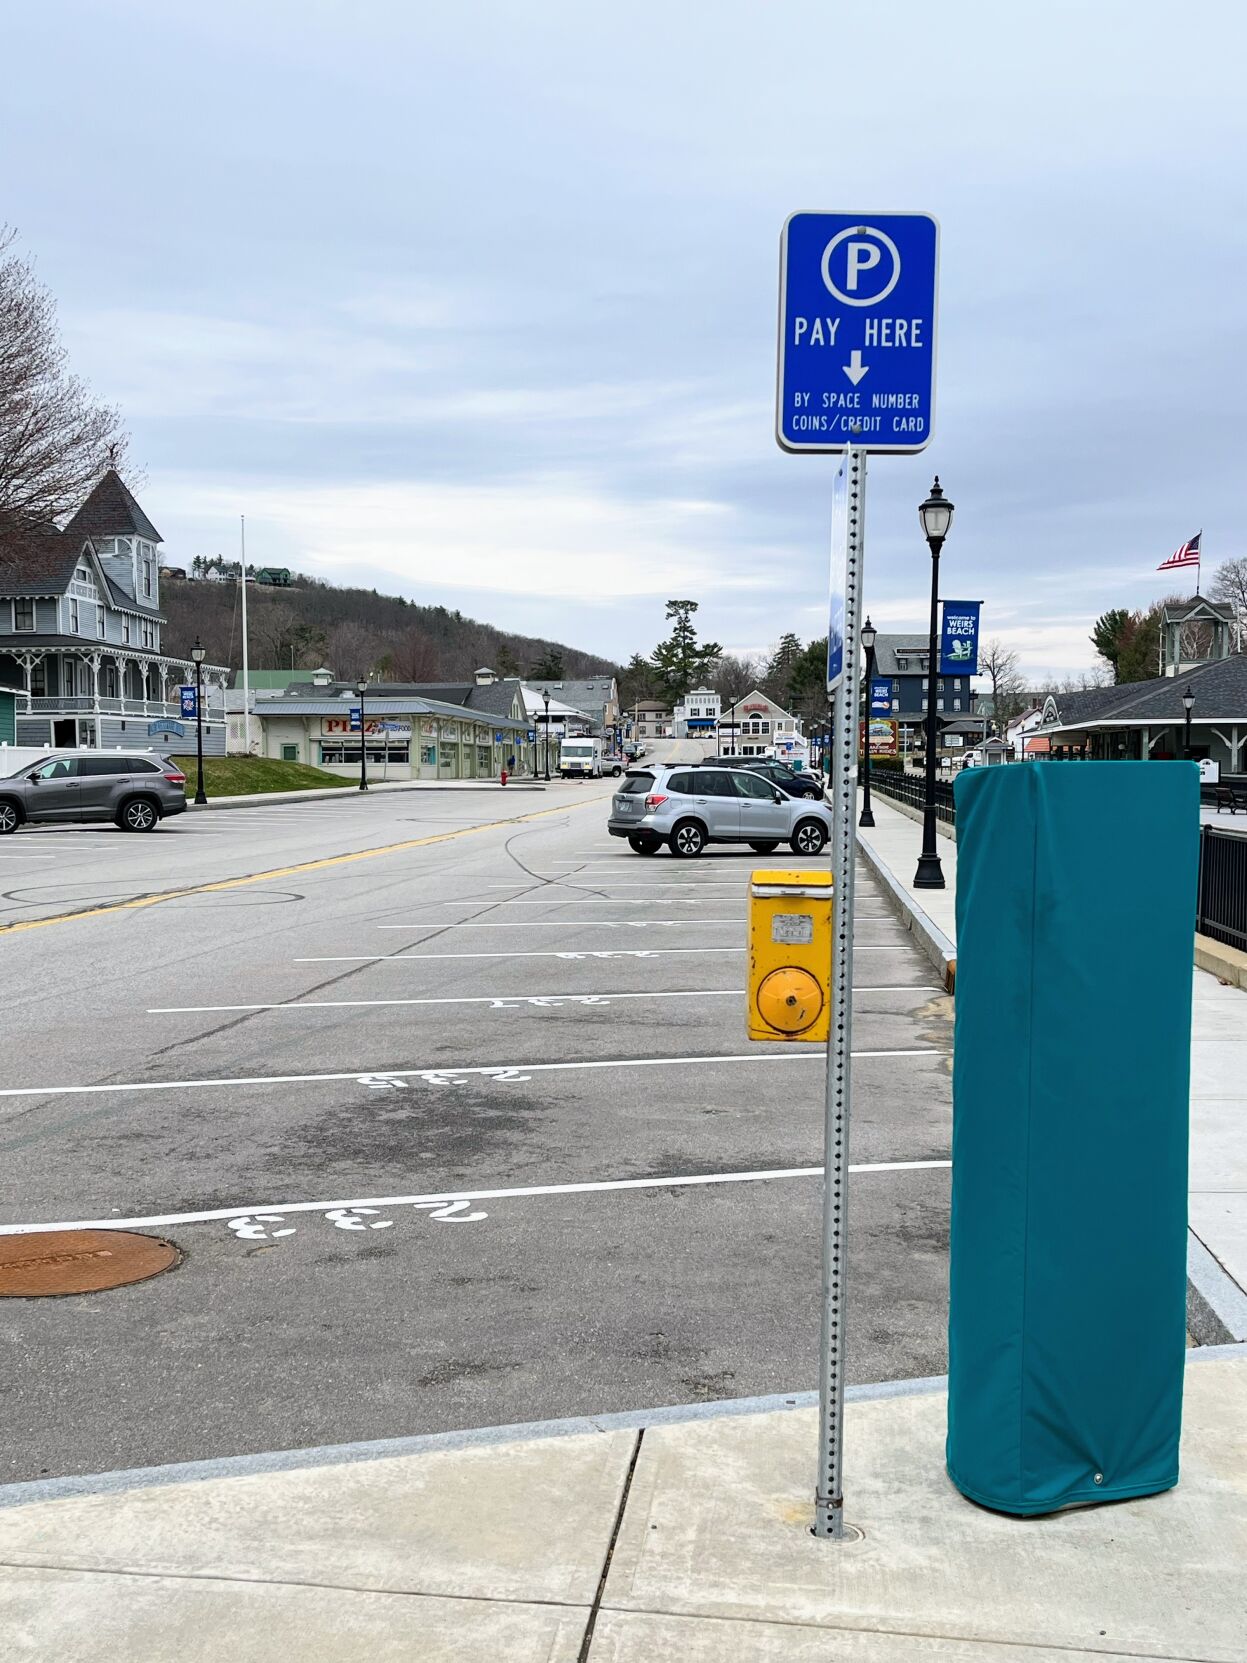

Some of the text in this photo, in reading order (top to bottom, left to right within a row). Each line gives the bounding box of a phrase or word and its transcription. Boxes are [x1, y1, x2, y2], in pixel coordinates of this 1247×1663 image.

[846, 242, 881, 290] P
[794, 317, 923, 347] PAY HERE
[794, 392, 919, 409] BY SPACE NUMBER
[792, 415, 924, 432] COINS/CREDIT CARD
[946, 627, 975, 635] BEACH
[949, 620, 974, 628] WEIRS
[356, 1070, 531, 1088] 235
[227, 1200, 489, 1239] 233
